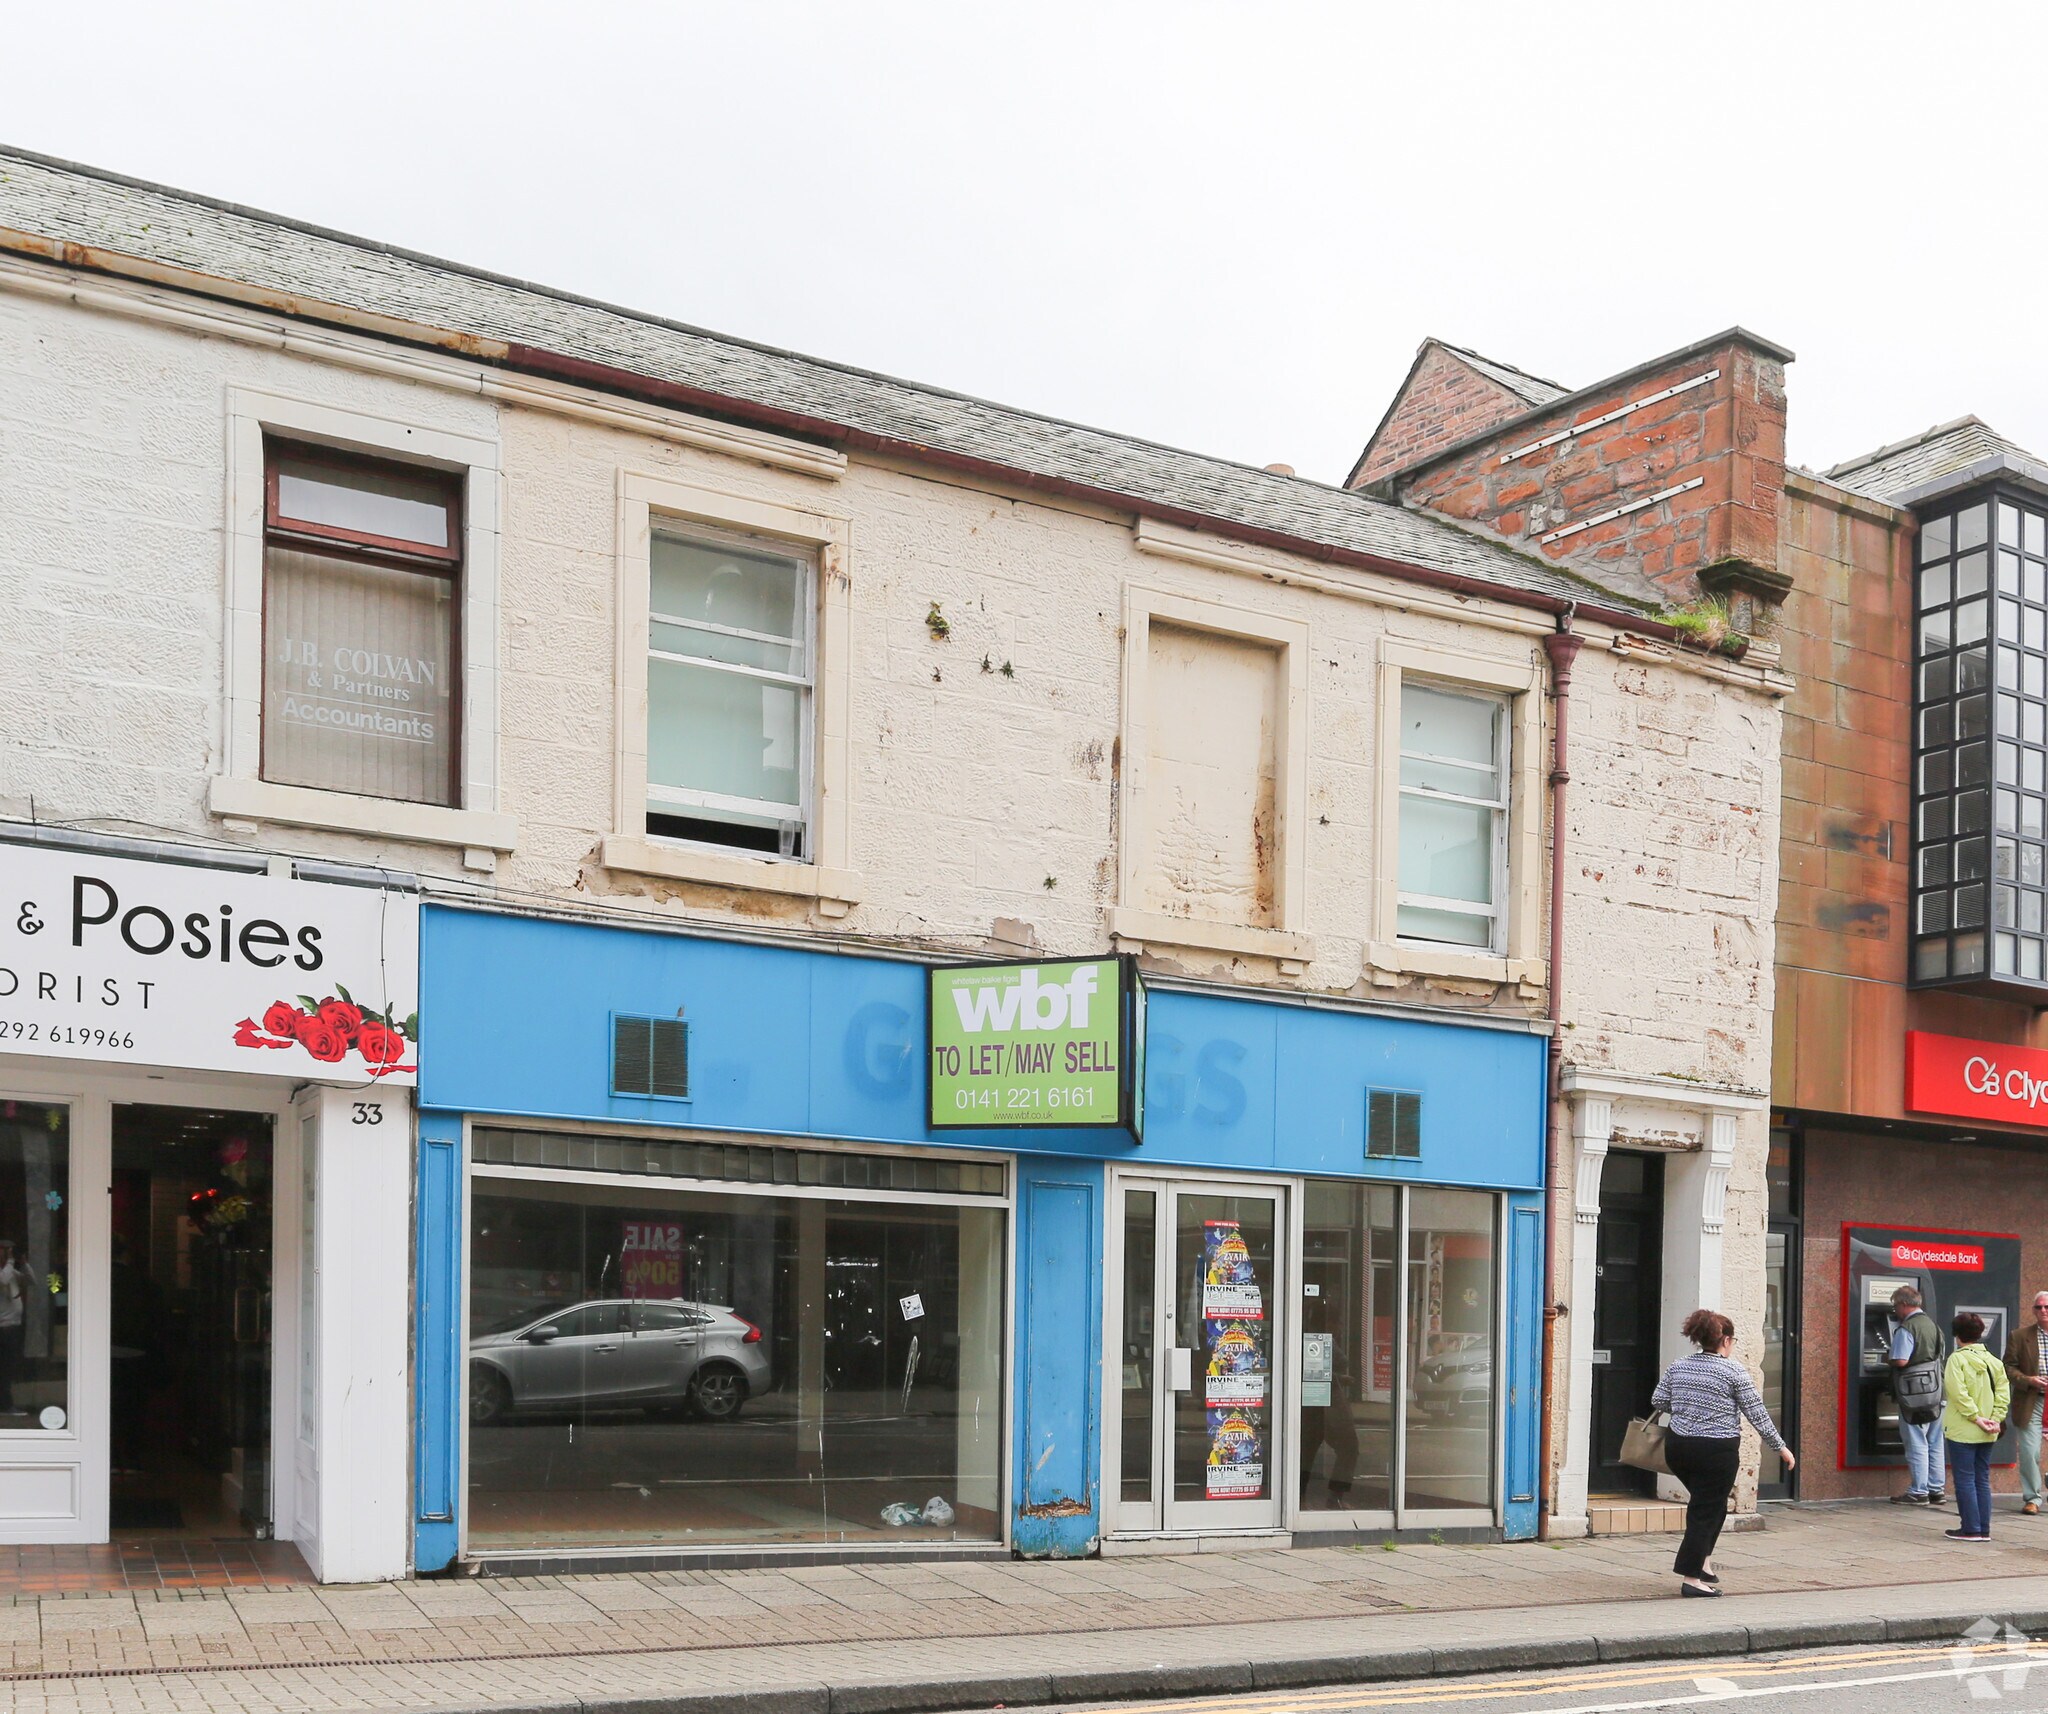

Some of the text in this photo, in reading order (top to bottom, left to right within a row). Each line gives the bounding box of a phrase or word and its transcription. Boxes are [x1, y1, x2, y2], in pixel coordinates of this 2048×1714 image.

[279, 638, 436, 686] J.B. COLVAN
[307, 670, 410, 702] & Partners
[281, 697, 435, 739] Accountants
[17, 875, 324, 971] & Posies
[951, 965, 1098, 1033] wbf
[49, 1024, 134, 1049] 619966
[935, 1045, 961, 1077] TO
[1064, 1040, 1116, 1074] SELL
[955, 1086, 1094, 1109] 0141 221 6161
[352, 1101, 383, 1125] 33
[992, 1110, 1054, 1121] www.wbf.co.uk
[1911, 1249, 1957, 1263] Clydesdale
[1958, 1252, 1978, 1264] Bank
[1225, 1344, 1250, 1352] ZYAIR
[1225, 1432, 1249, 1441] ZYAIR
